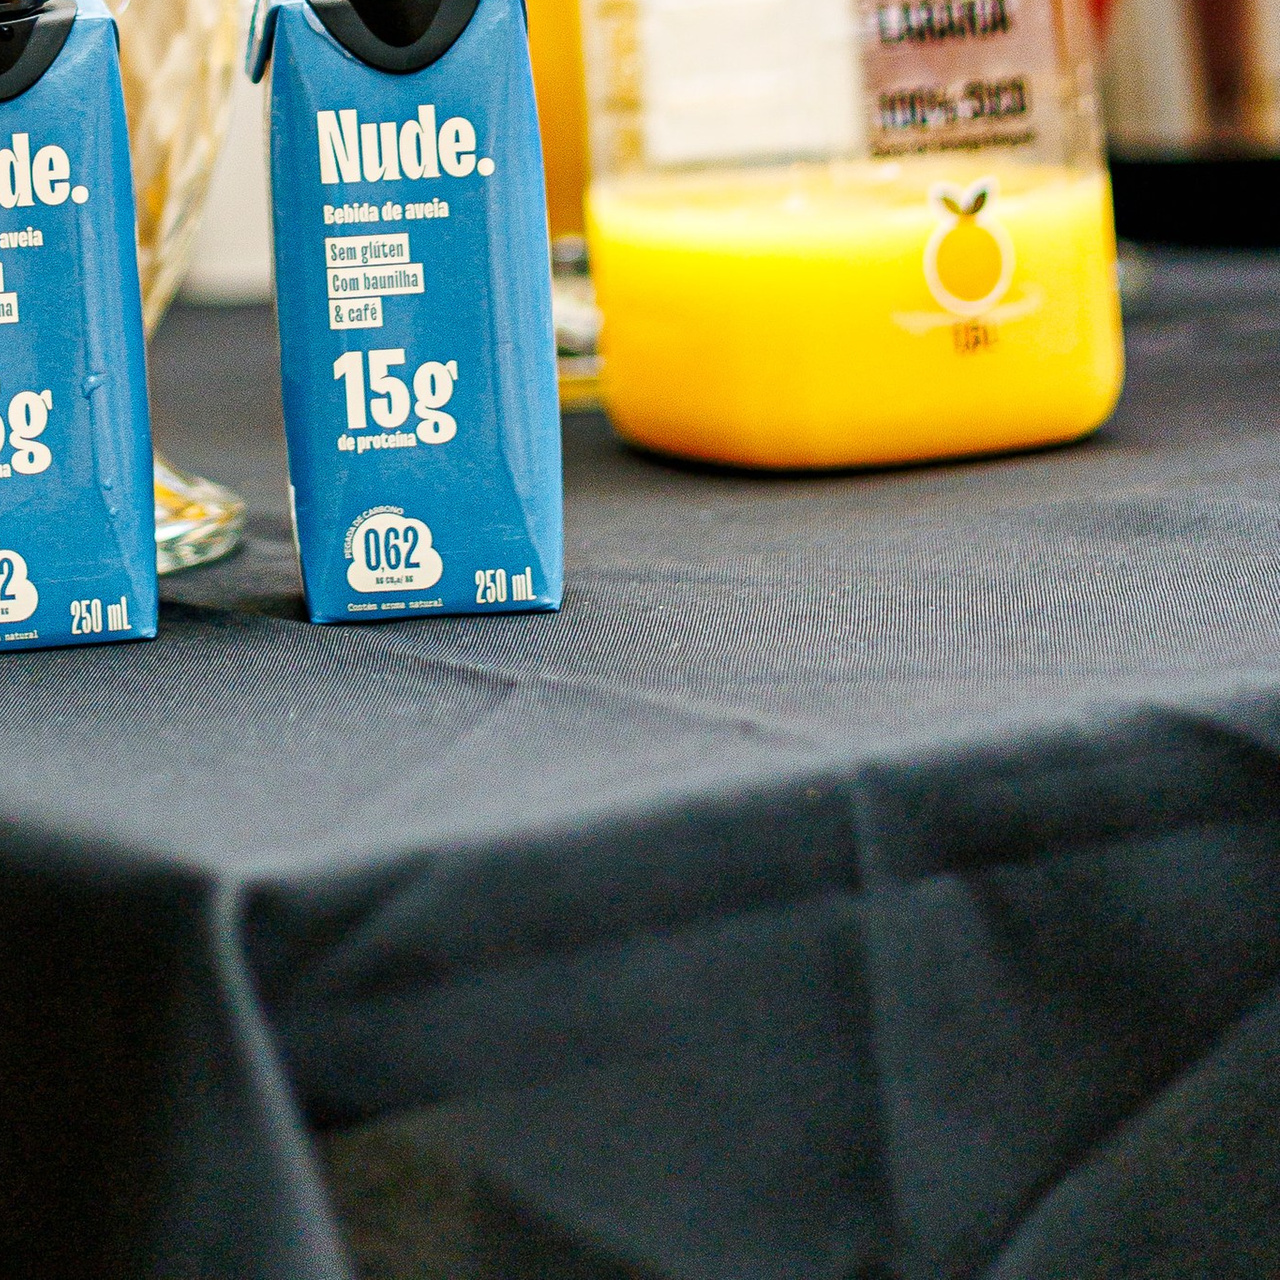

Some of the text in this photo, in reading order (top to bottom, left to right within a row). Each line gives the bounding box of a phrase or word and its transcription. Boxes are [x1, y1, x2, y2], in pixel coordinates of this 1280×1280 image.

[317, 104, 496, 185] Nude.
[323, 197, 449, 225] Bebida de aveia
[0, 226, 44, 249] aveia
[330, 240, 404, 264] Sem glúten
[332, 270, 419, 292] Com baunilha
[334, 303, 377, 323] & café
[333, 348, 458, 445] 15g
[337, 430, 417, 455] de proteína
[364, 526, 420, 572] 0,62
[475, 566, 537, 603] 250 mL
[70, 596, 132, 635] 250 mL
